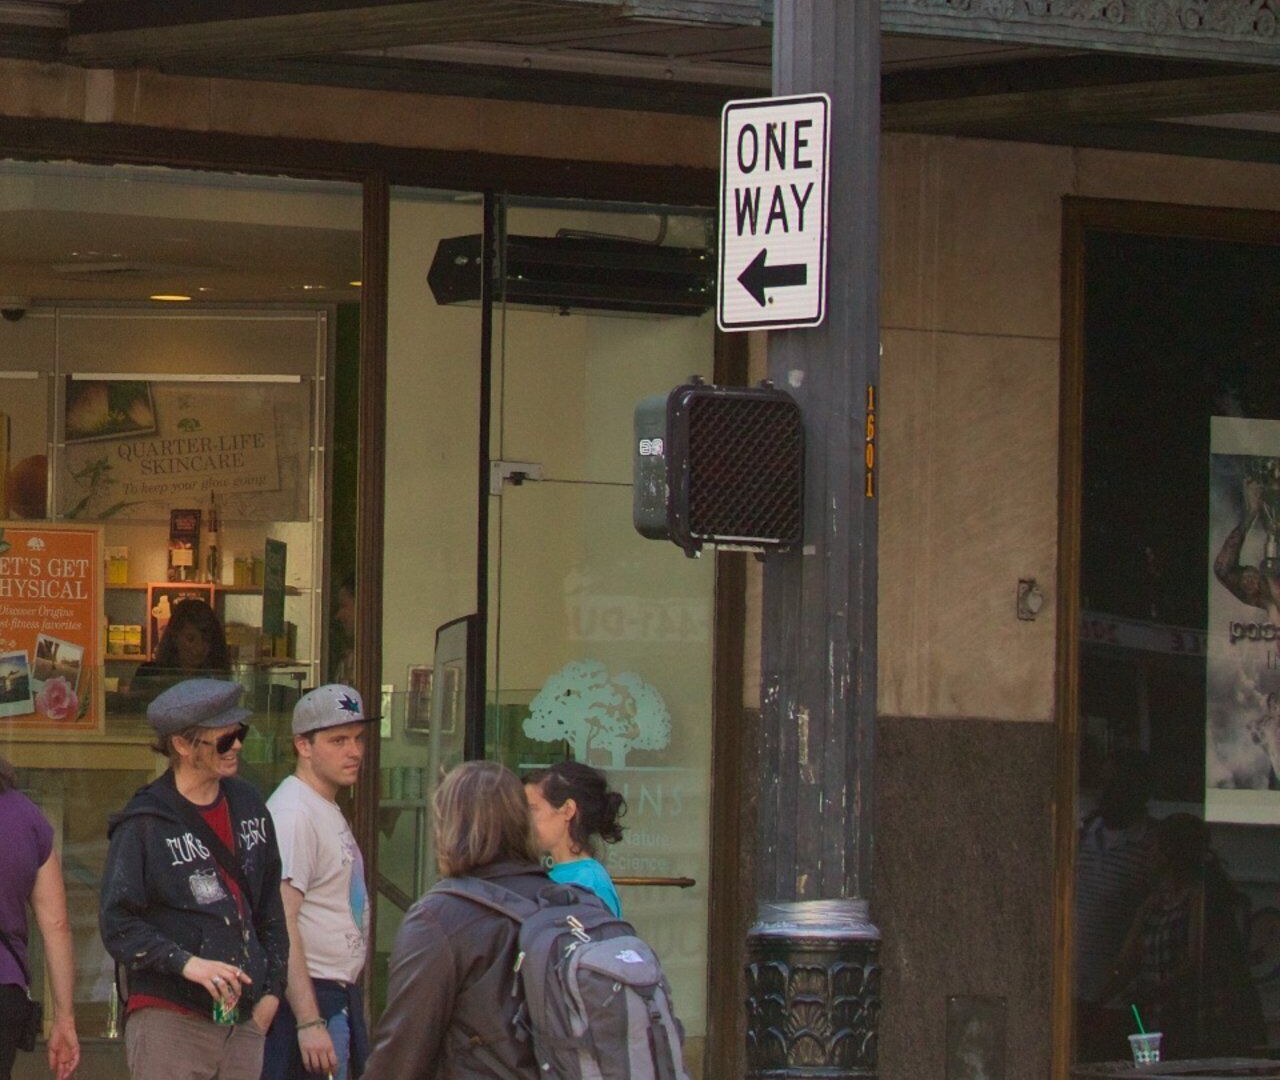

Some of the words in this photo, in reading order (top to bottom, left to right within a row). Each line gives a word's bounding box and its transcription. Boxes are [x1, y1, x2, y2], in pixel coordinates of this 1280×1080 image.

[737, 119, 813, 174] ONE
[734, 182, 814, 236] WAY
[140, 453, 245, 475] SKINCARE
[47, 558, 89, 578] GET
